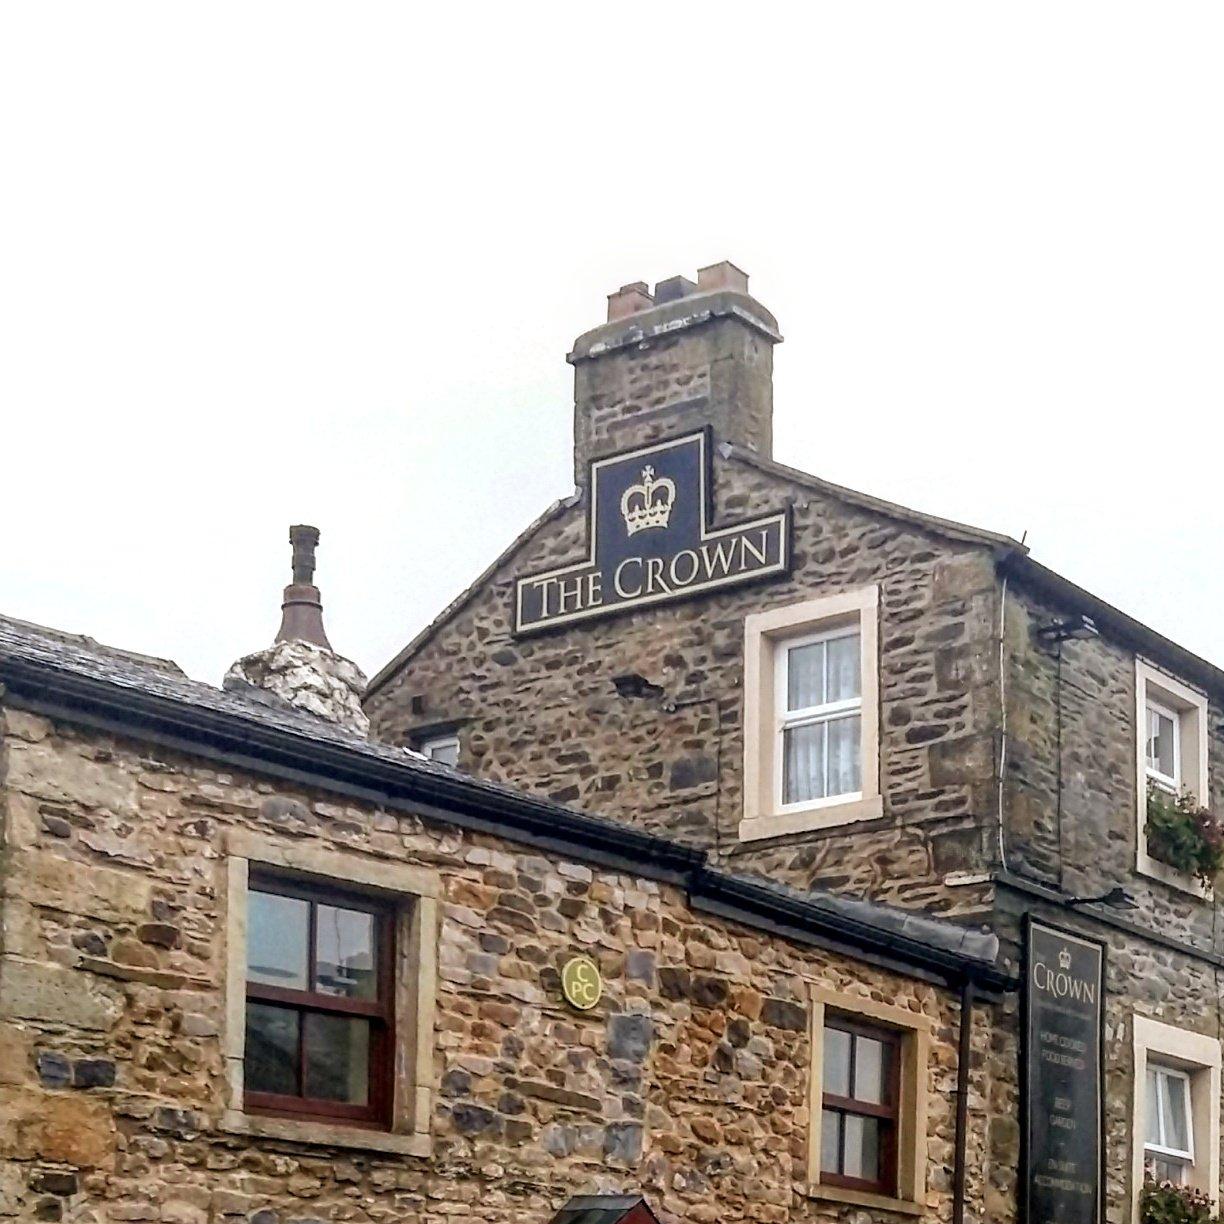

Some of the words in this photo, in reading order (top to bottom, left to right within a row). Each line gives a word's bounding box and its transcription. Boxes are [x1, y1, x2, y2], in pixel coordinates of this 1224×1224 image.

[533, 571, 603, 618] THE
[613, 529, 769, 599] CROWN
[577, 964, 588, 982] C
[1033, 962, 1095, 1004] CROWN
[572, 981, 595, 1001] PC
